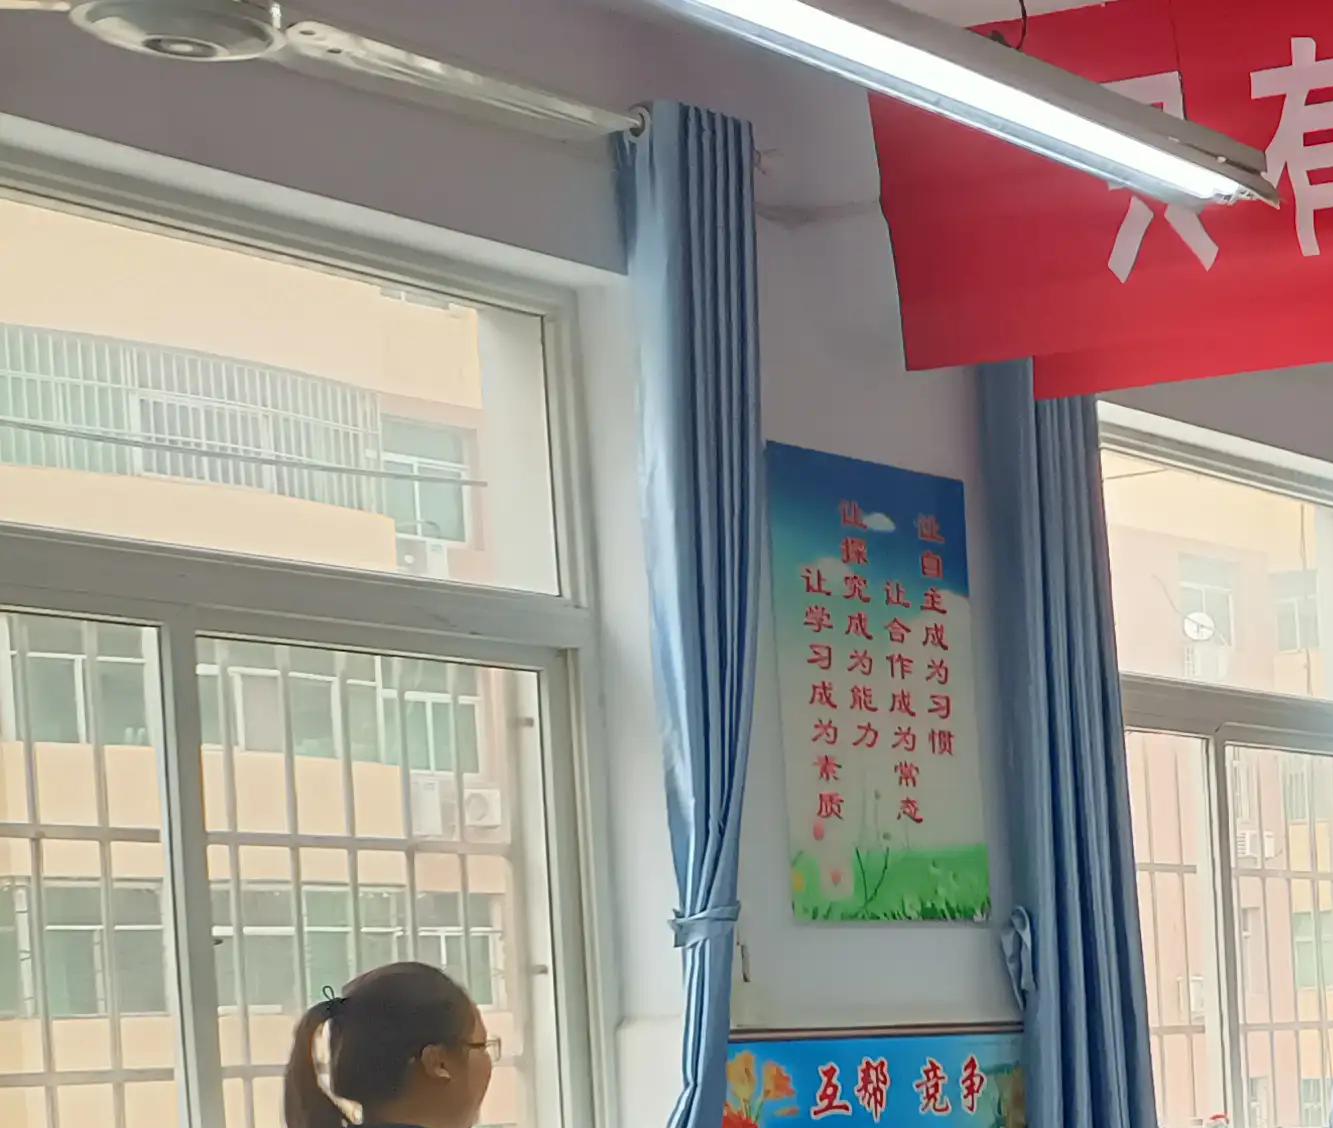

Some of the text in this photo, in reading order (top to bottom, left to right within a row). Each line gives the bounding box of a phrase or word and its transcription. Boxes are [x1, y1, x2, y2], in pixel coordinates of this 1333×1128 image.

[800, 567, 846, 821] 让学习成为素质
[839, 500, 880, 750] 让探究成为能力
[883, 580, 925, 825] 让合作成为常态
[916, 513, 957, 758] 让自主成为习惯
[811, 1055, 987, 1123] 互帮 竞争
